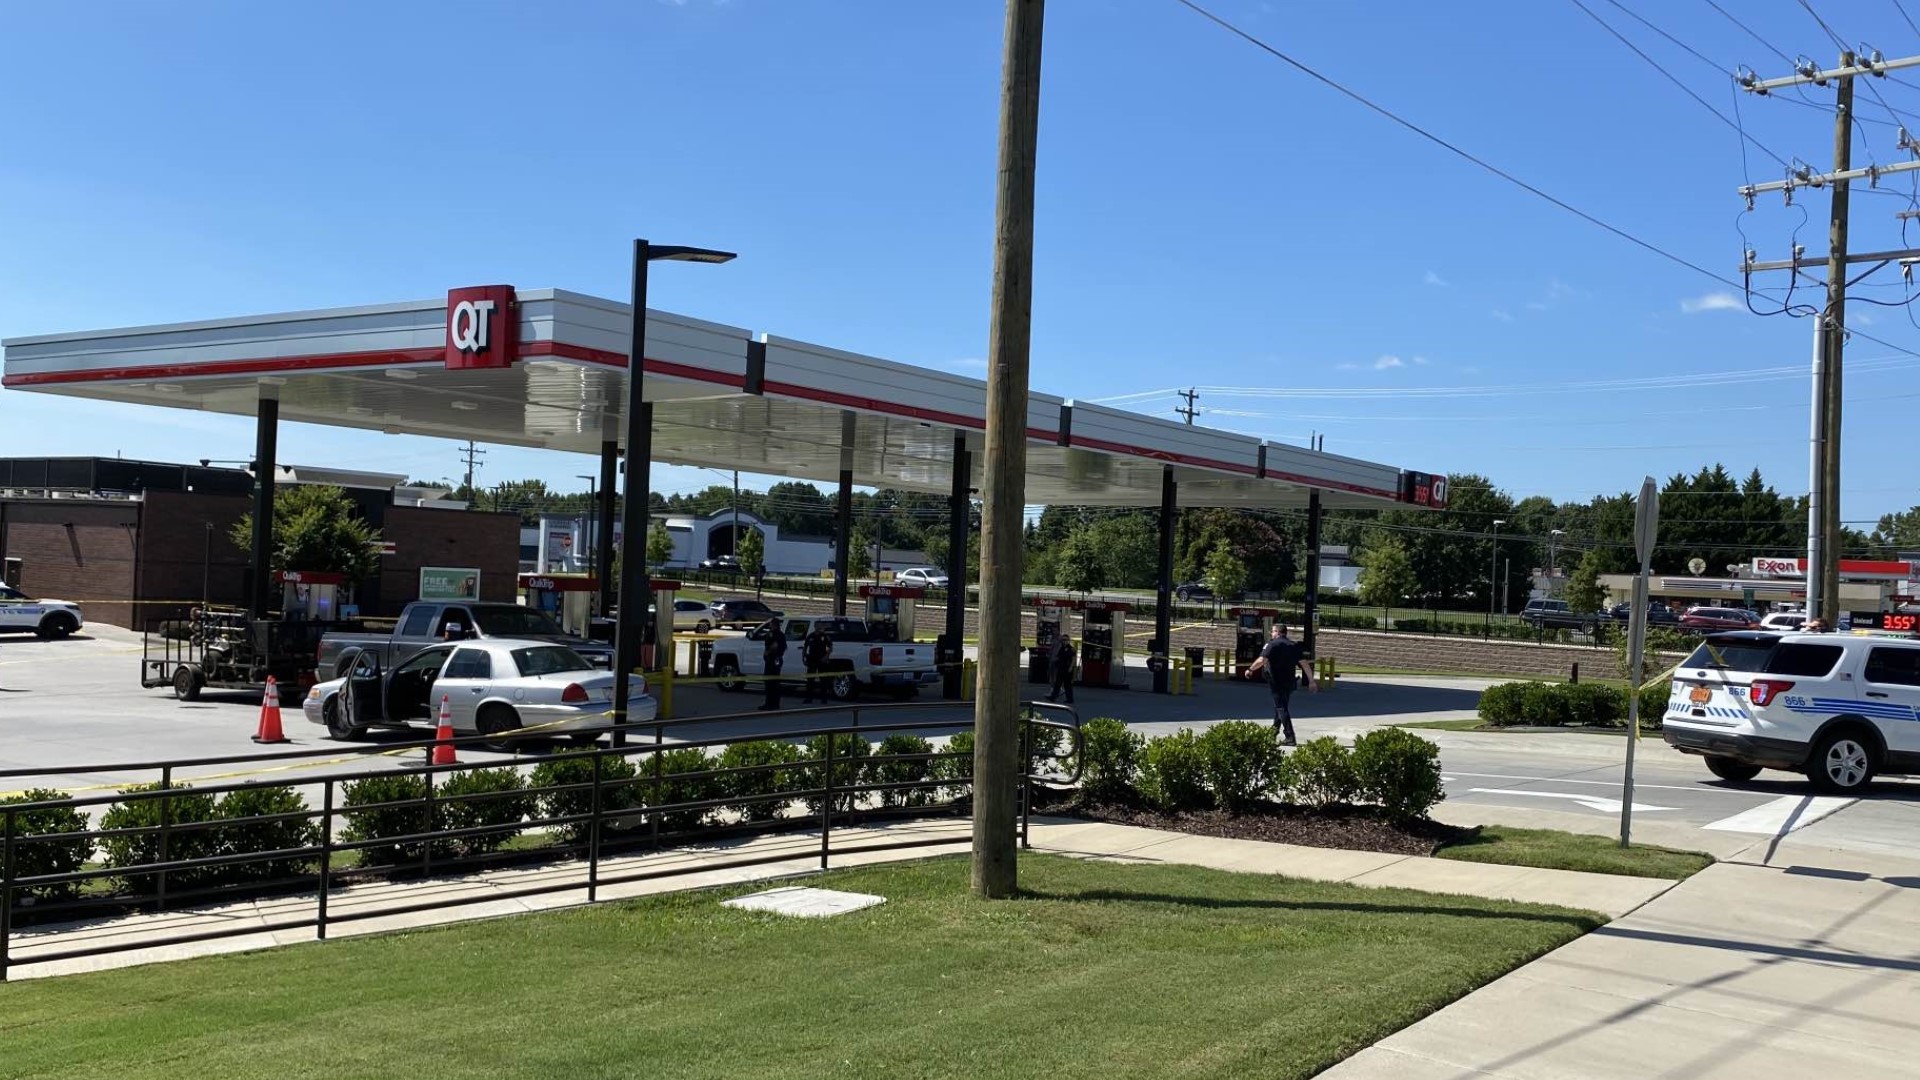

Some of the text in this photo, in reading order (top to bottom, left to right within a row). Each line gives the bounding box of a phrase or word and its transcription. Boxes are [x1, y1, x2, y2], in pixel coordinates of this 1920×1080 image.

[451, 300, 494, 352] QT
[1757, 559, 1796, 574] Exxon
[1728, 687, 1746, 697] 866
[1784, 695, 1806, 706] 866
